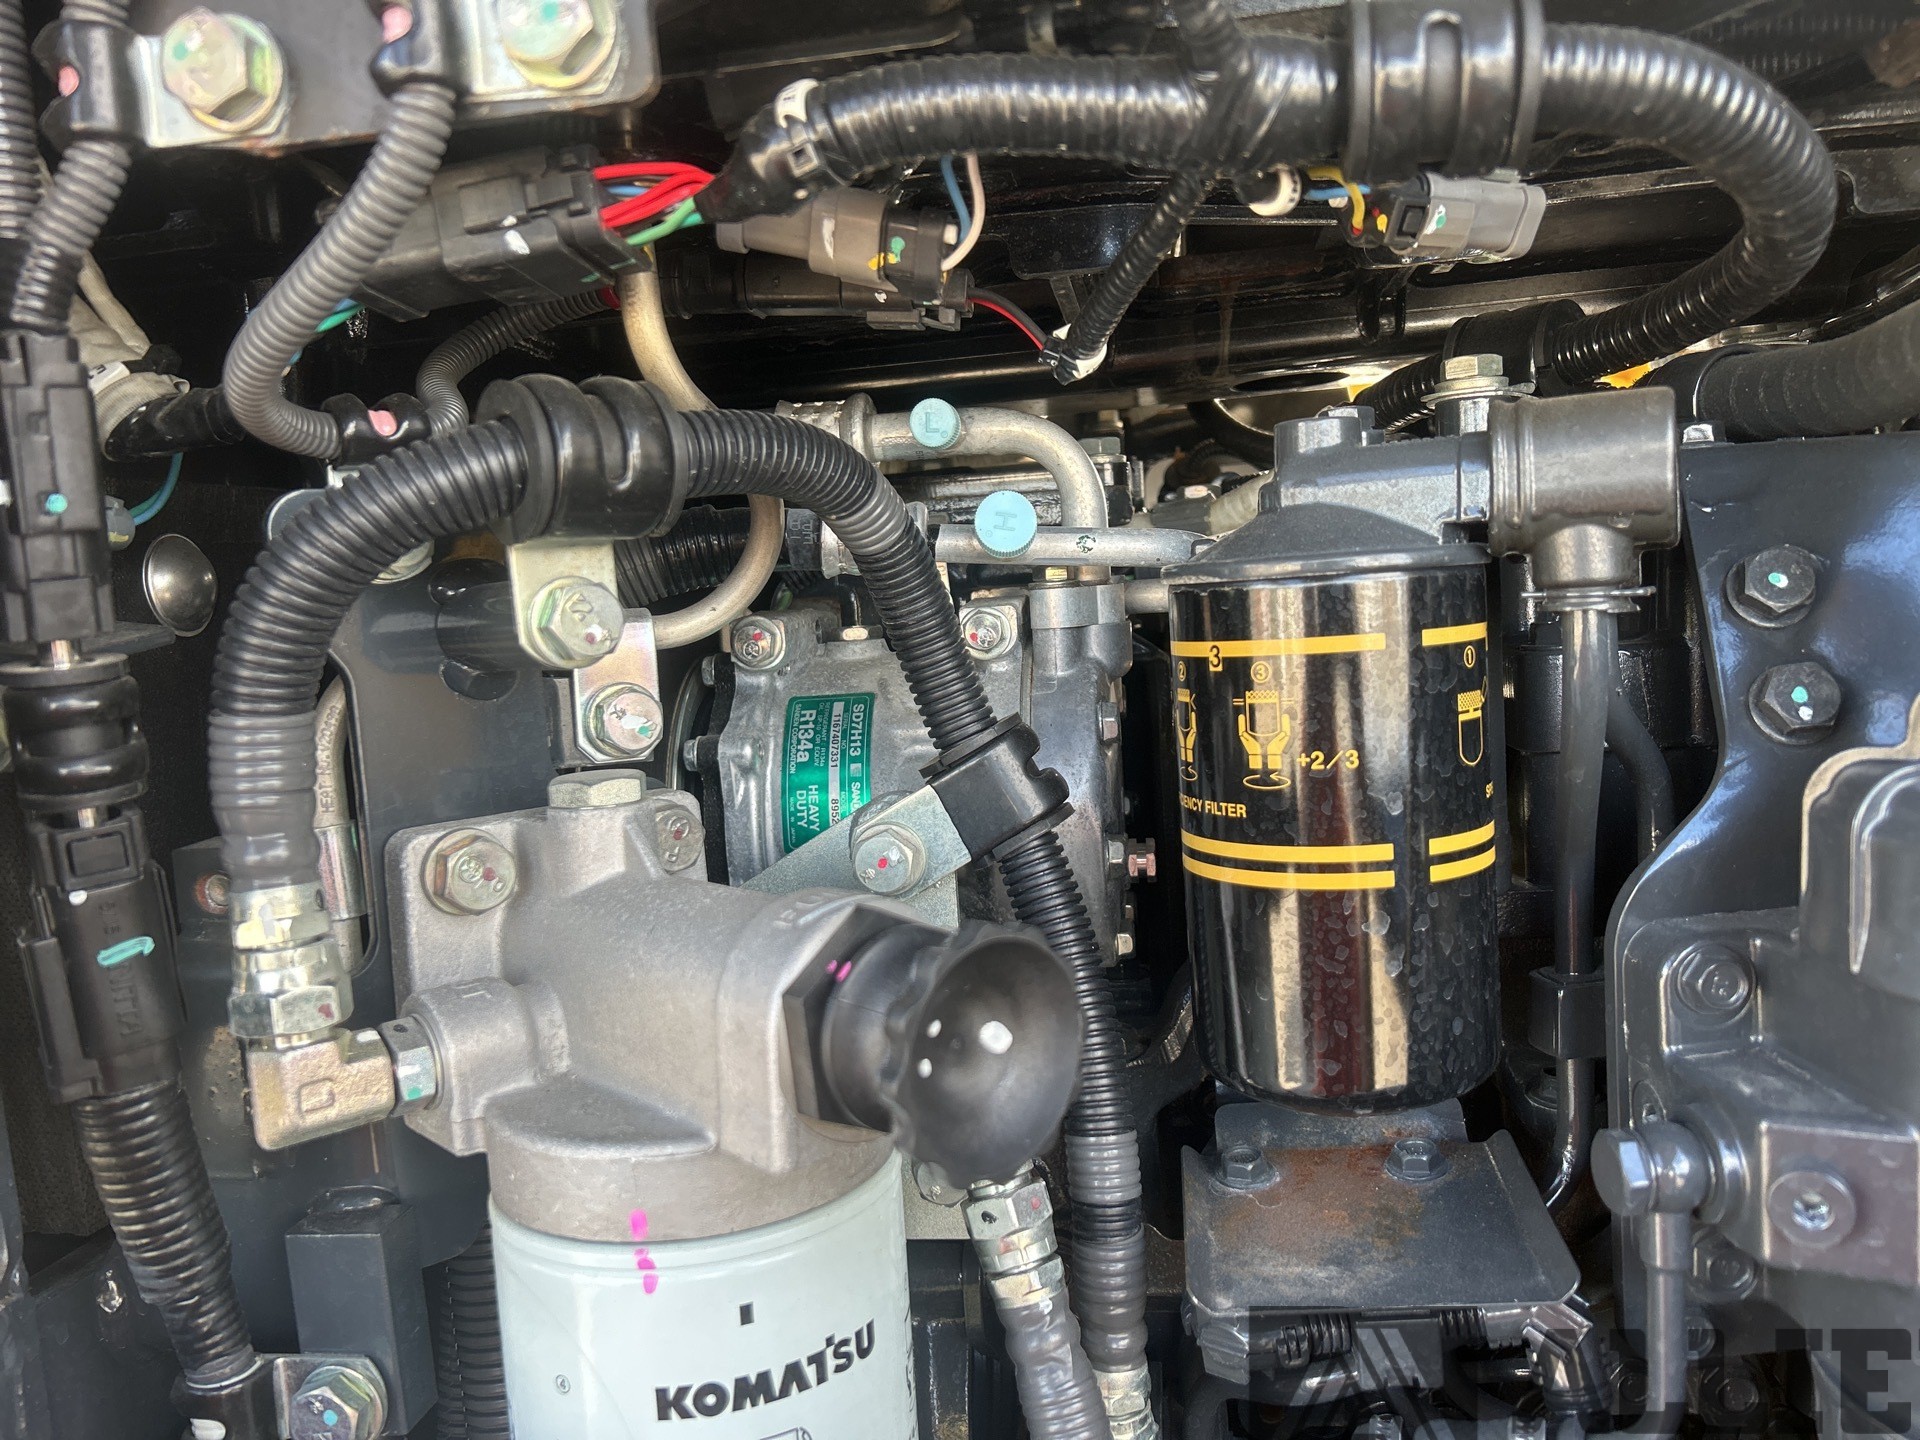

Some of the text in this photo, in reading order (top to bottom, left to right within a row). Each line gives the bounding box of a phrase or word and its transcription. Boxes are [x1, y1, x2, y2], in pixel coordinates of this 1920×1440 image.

[1208, 644, 1222, 669] 3
[789, 703, 802, 774] SANDEN CORPORATION
[796, 709, 817, 763] R134a
[815, 734, 821, 744] OR
[830, 713, 842, 768] 1167407331
[849, 703, 865, 757] SD7H13
[1296, 749, 1361, 771] +2/3
[796, 790, 808, 828] DUTY
[808, 784, 820, 832] HEAVY
[1204, 799, 1248, 818] FILTER
[654, 1318, 876, 1421] KOMATSU
